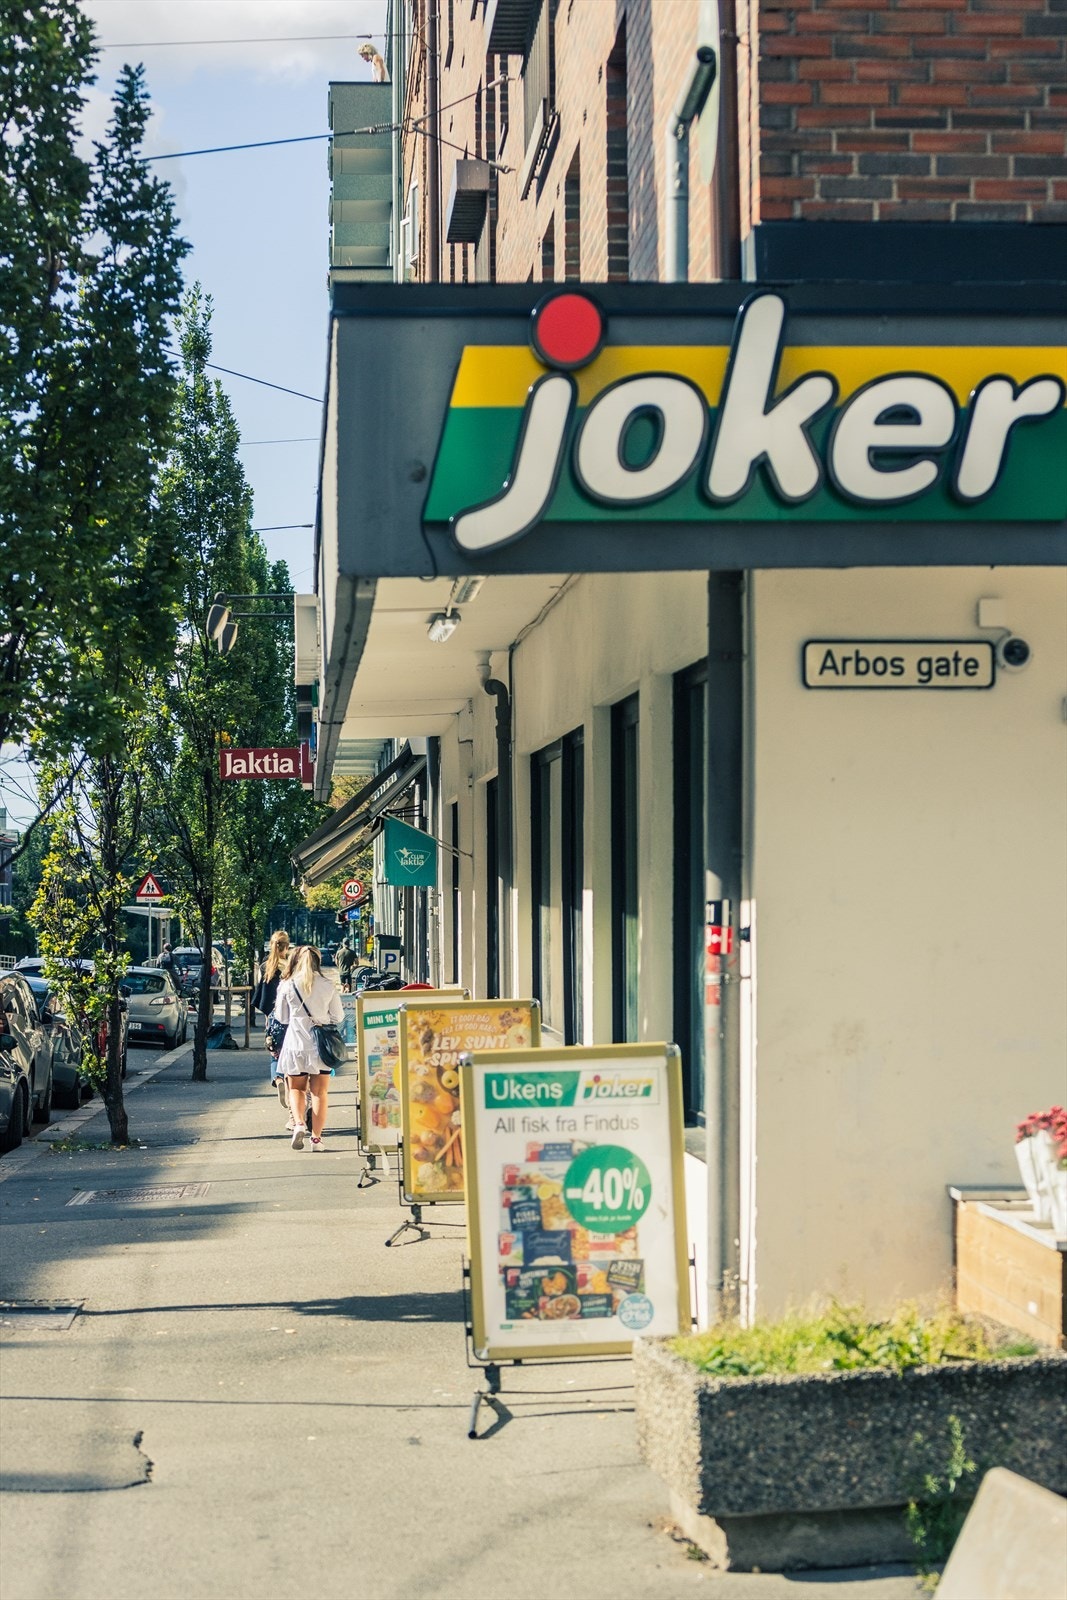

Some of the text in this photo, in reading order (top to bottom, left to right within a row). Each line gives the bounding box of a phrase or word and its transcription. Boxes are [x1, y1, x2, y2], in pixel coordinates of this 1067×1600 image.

[450, 290, 1064, 554] joker
[818, 649, 980, 684] Arbos gate
[224, 750, 295, 777] Jaktia
[346, 885, 360, 894] 40
[385, 953, 397, 971] P
[366, 1015, 384, 1025] MINI
[431, 1034, 509, 1051] LEV SUNT.
[491, 1074, 653, 1103] Ukens joker
[494, 1114, 640, 1134] All fisk fra Findus
[566, 1167, 645, 1211] -40%
